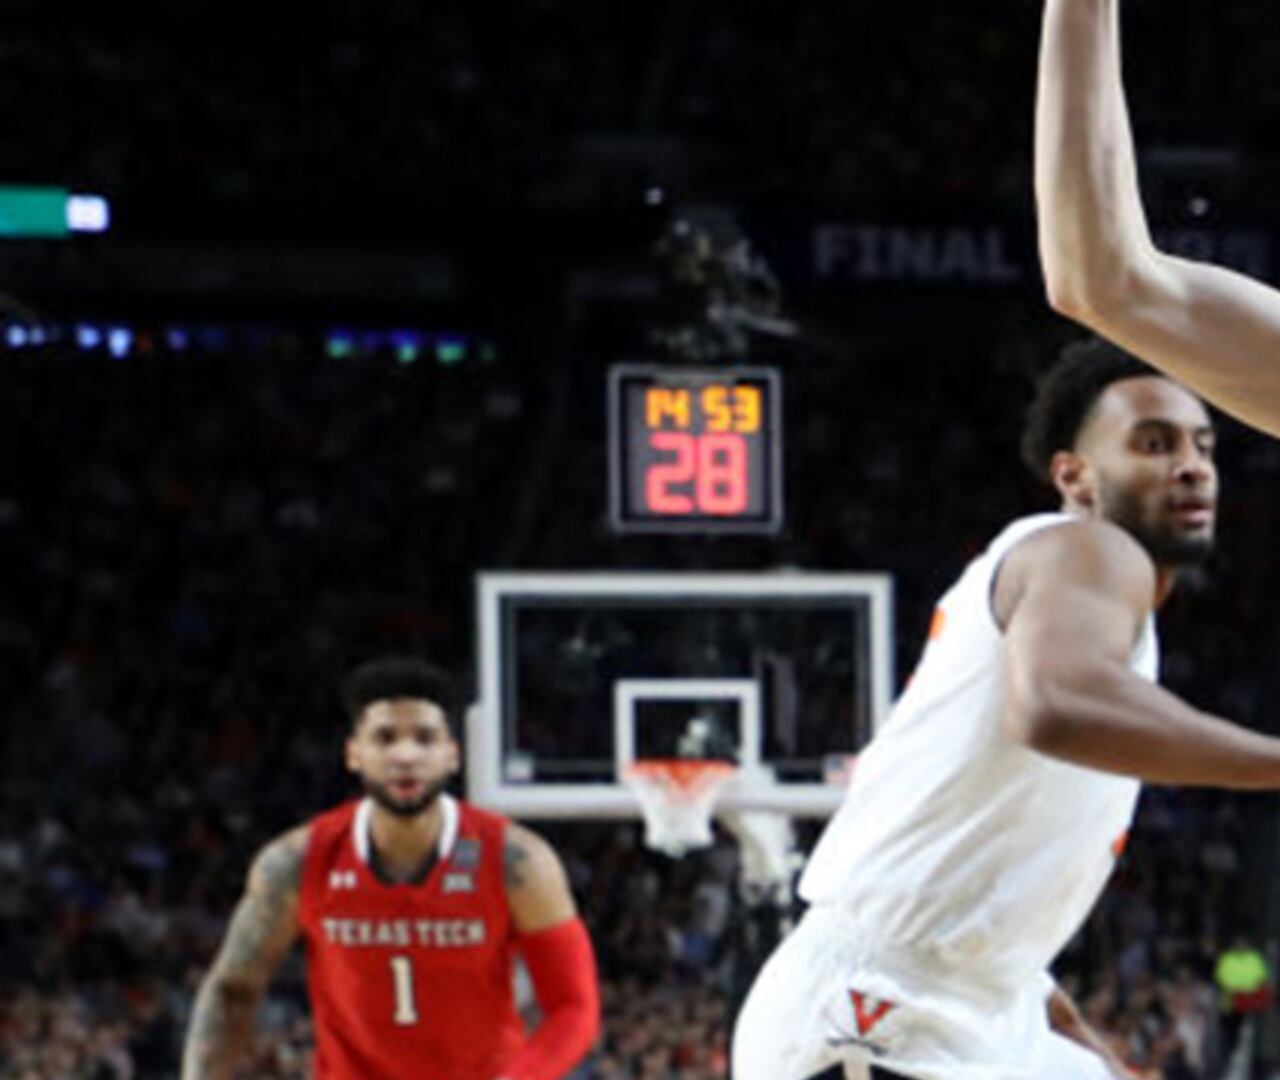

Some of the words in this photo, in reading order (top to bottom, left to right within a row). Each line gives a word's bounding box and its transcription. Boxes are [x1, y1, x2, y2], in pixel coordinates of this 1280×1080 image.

[812, 226, 1018, 282] FINAL
[644, 431, 749, 515] 28
[322, 917, 410, 947] TEXAS
[414, 917, 486, 947] TECH
[390, 954, 419, 1025] 1
